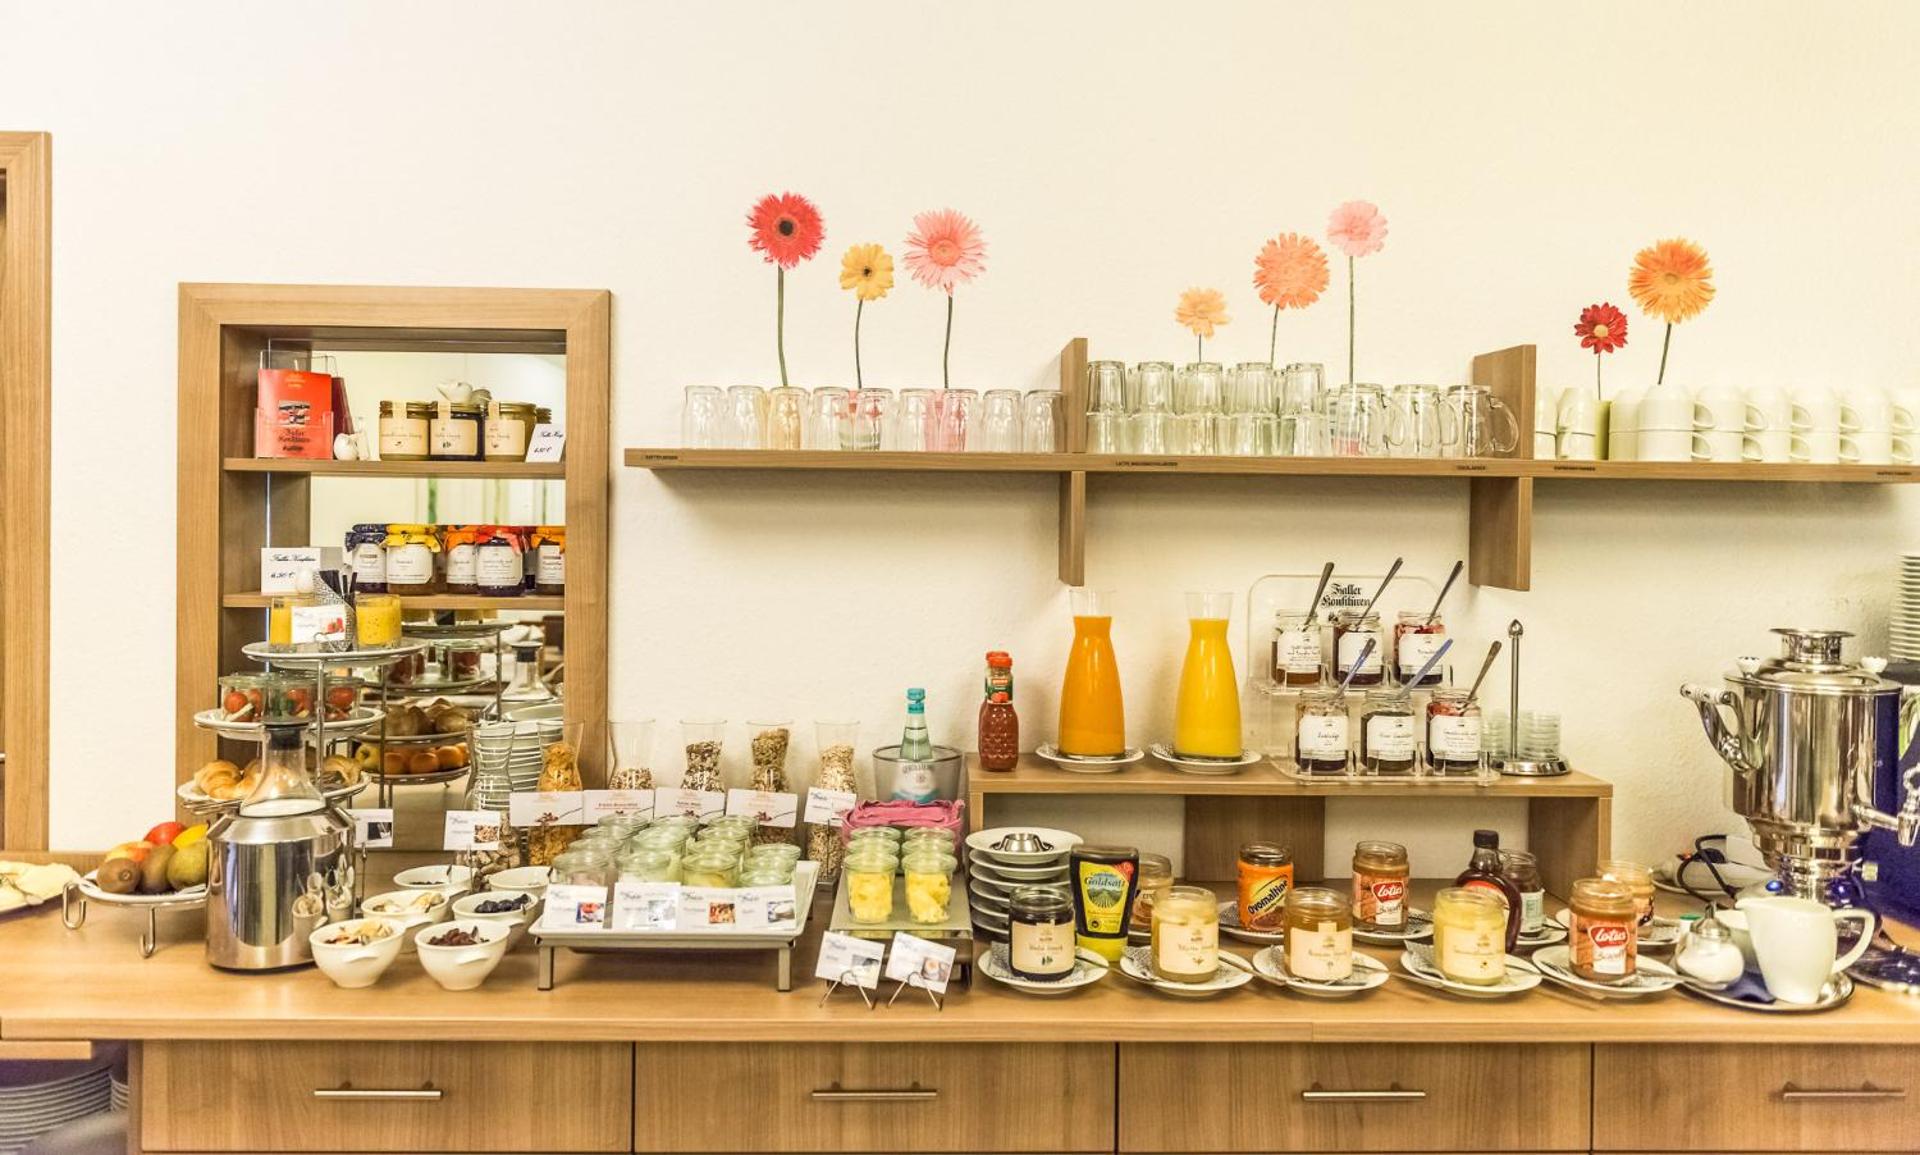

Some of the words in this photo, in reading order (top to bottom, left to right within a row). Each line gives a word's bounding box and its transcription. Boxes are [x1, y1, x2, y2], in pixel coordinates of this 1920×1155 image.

[1331, 583, 1361, 595] Faller
[1084, 876, 1126, 888] Goldsaft
[1247, 880, 1288, 914] Ovomaltine
[1377, 884, 1403, 898] Lotus
[1594, 928, 1627, 943] Lotus
